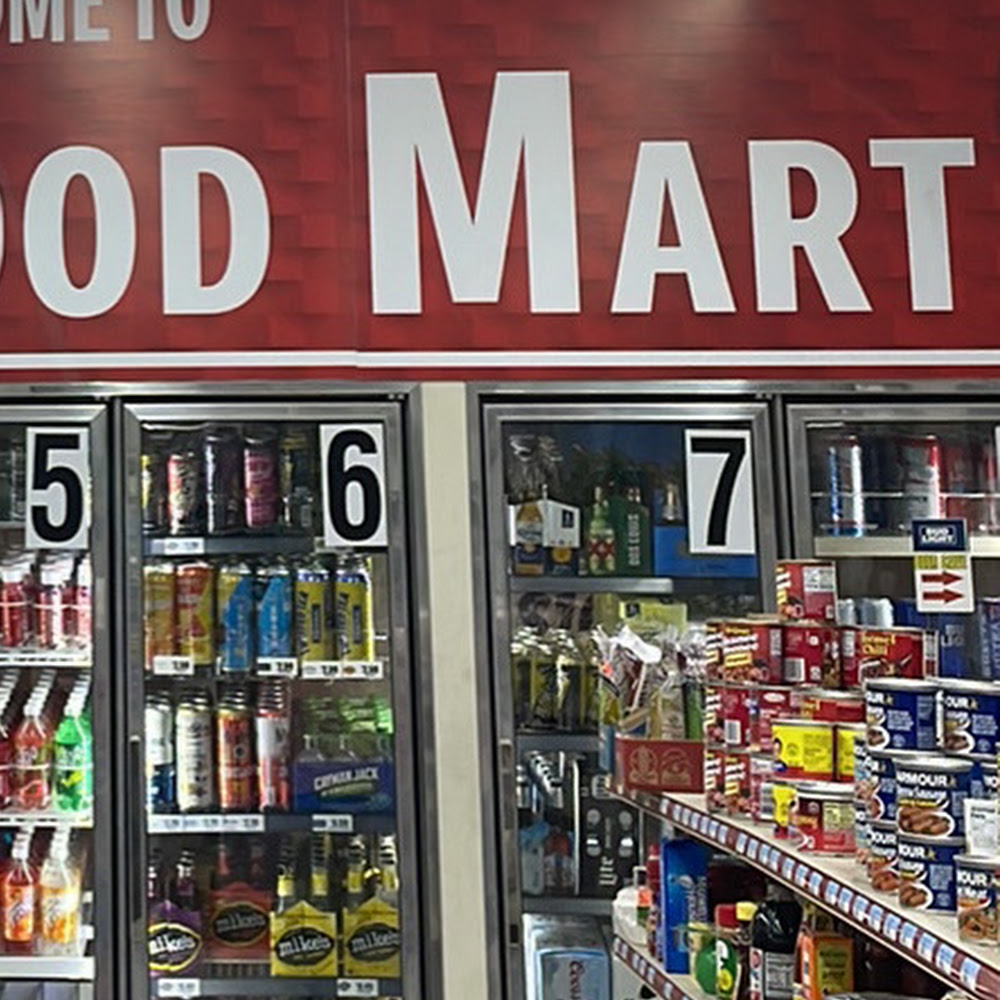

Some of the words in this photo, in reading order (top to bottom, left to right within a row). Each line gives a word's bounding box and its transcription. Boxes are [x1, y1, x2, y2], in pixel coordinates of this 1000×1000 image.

[364, 69, 977, 317] MART
[31, 433, 83, 543] 5
[327, 429, 382, 541] 6
[691, 437, 746, 546] 7
